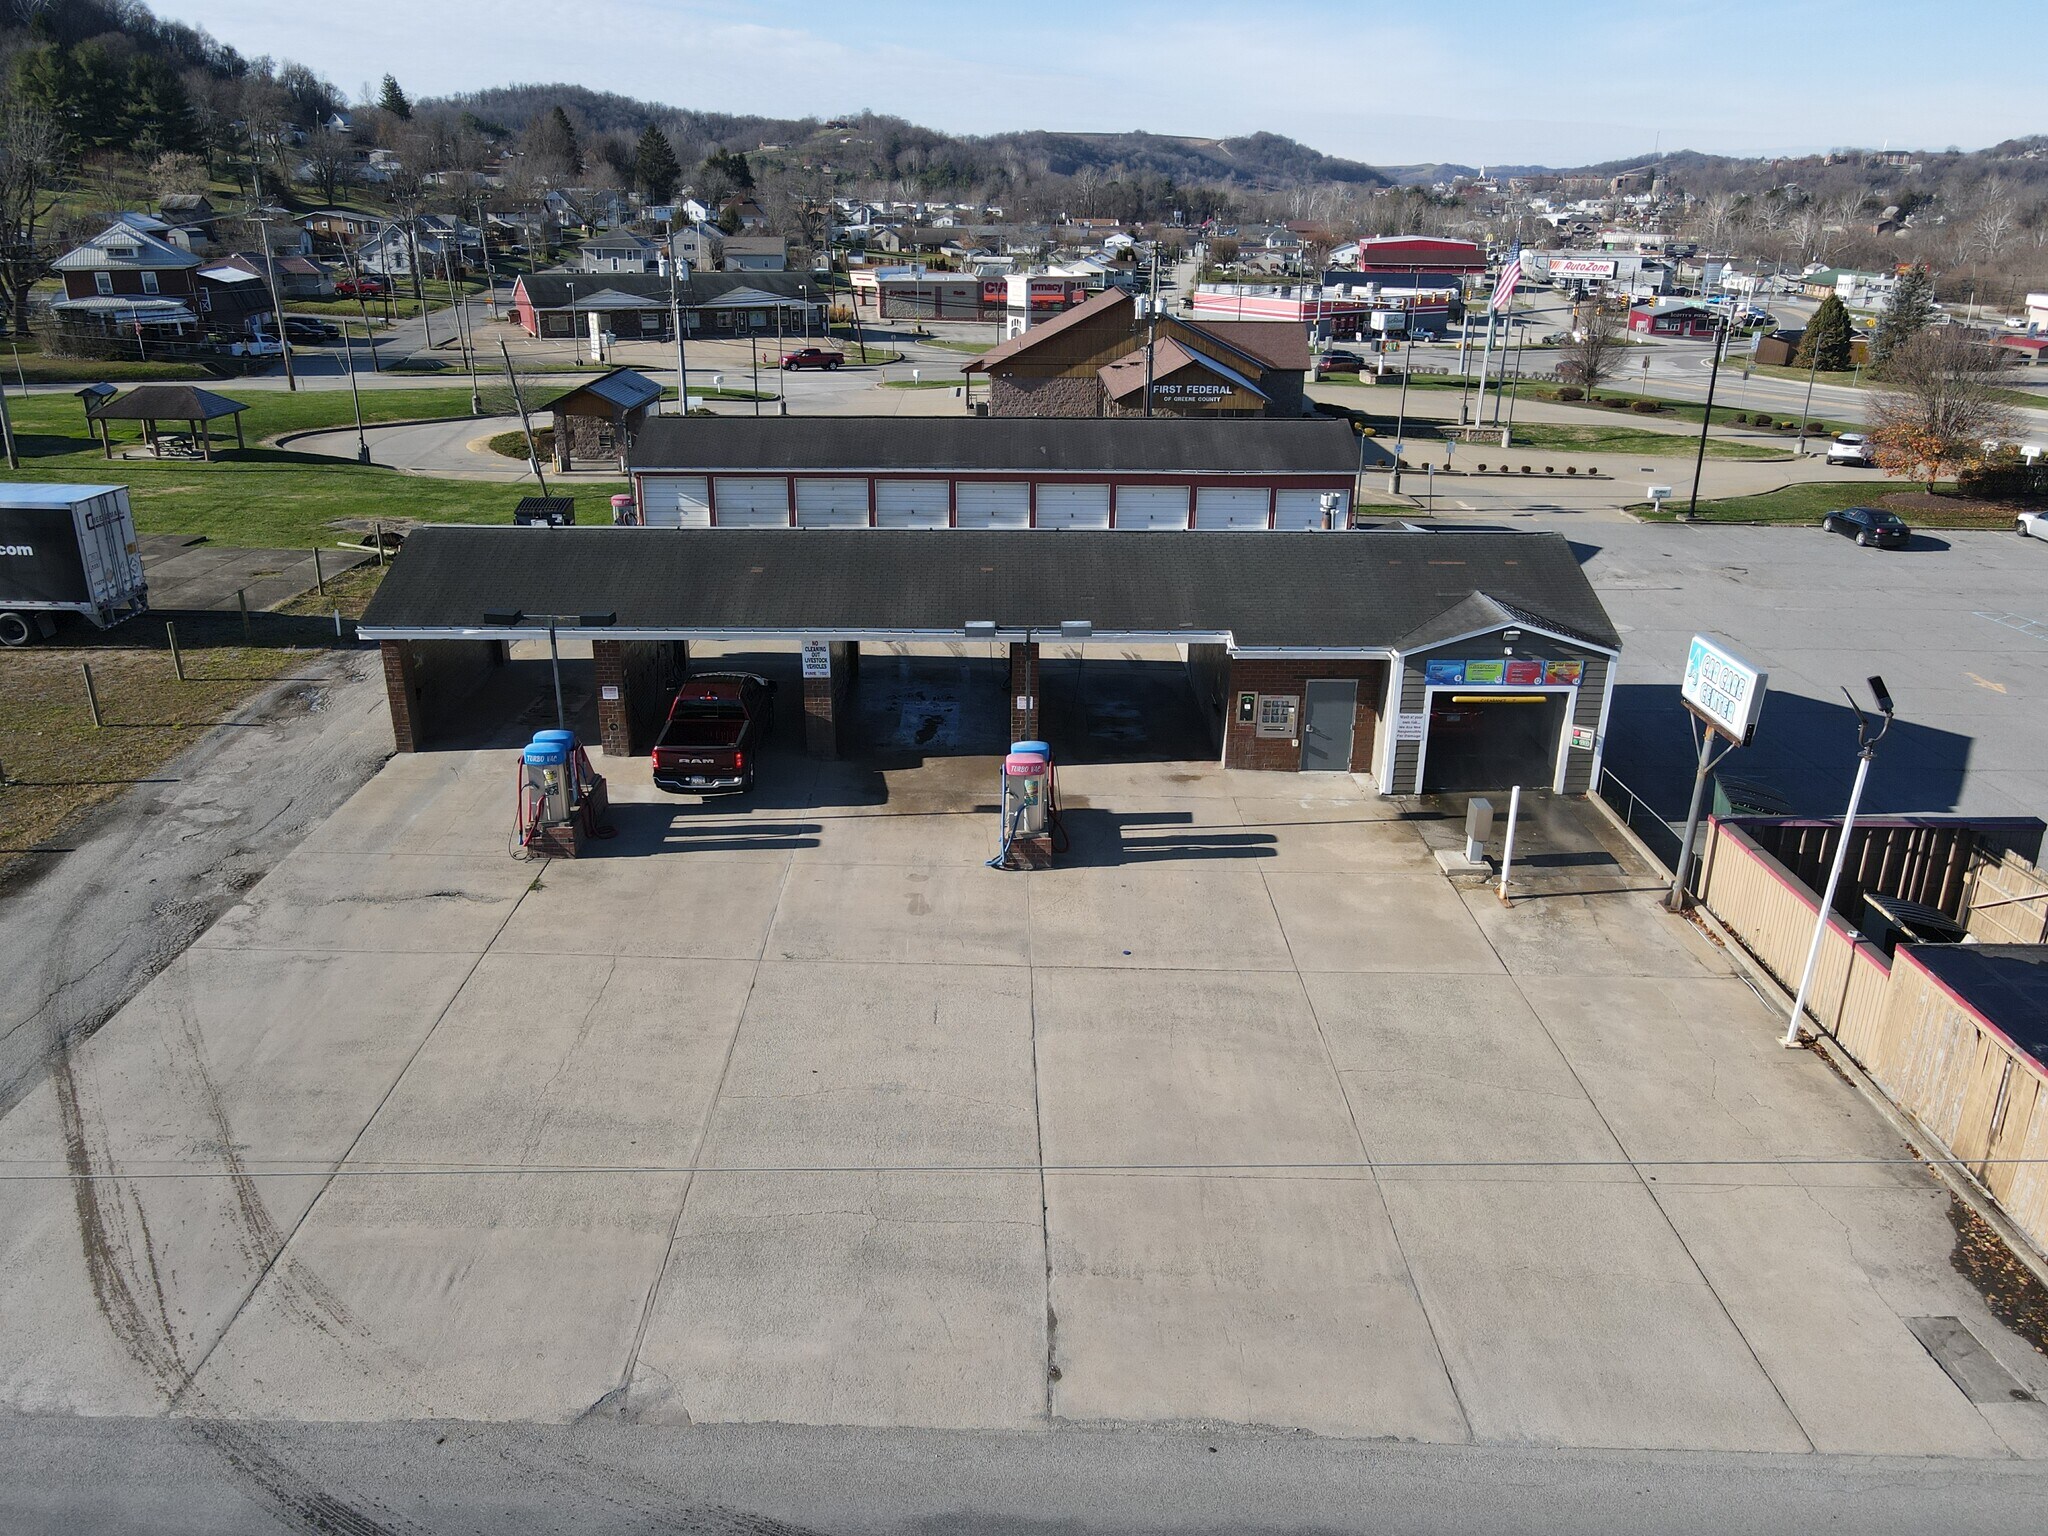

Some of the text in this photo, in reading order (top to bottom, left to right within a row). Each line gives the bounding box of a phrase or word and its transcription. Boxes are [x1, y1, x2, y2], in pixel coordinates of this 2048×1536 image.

[1563, 262, 1610, 272] AutoZone
[1153, 385, 1232, 394] FIRST FEDERAL
[1702, 655, 1746, 701] CAR CARE
[1700, 682, 1735, 724] CENTER
